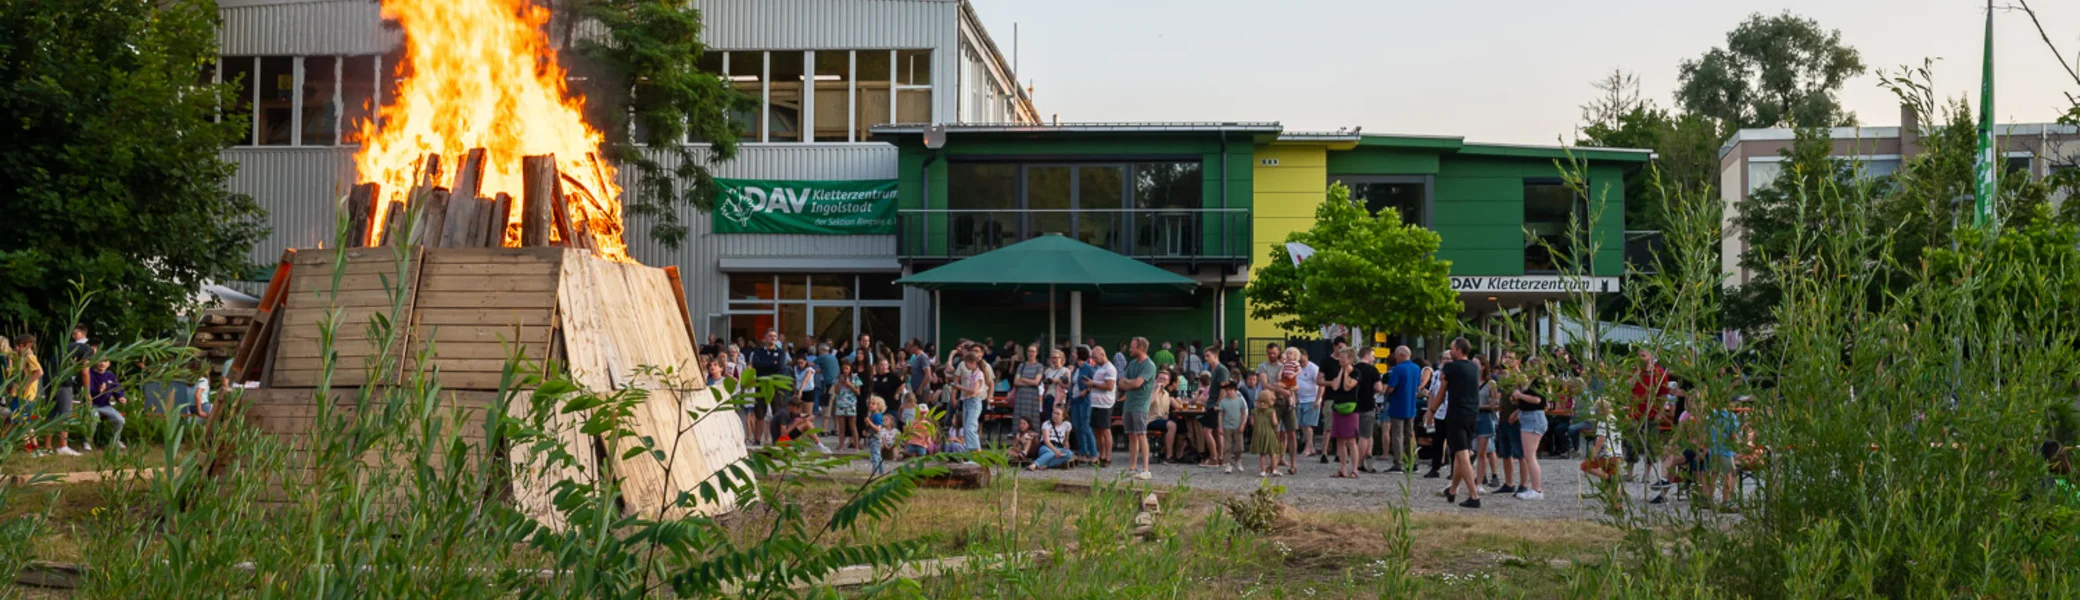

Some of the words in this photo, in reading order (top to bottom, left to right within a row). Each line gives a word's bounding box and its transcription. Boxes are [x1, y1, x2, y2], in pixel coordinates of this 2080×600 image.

[744, 187, 811, 213] DAV
[811, 201, 873, 215] Ingolstadt
[829, 218, 855, 226] Sektion
[1451, 277, 1483, 290] DAV
